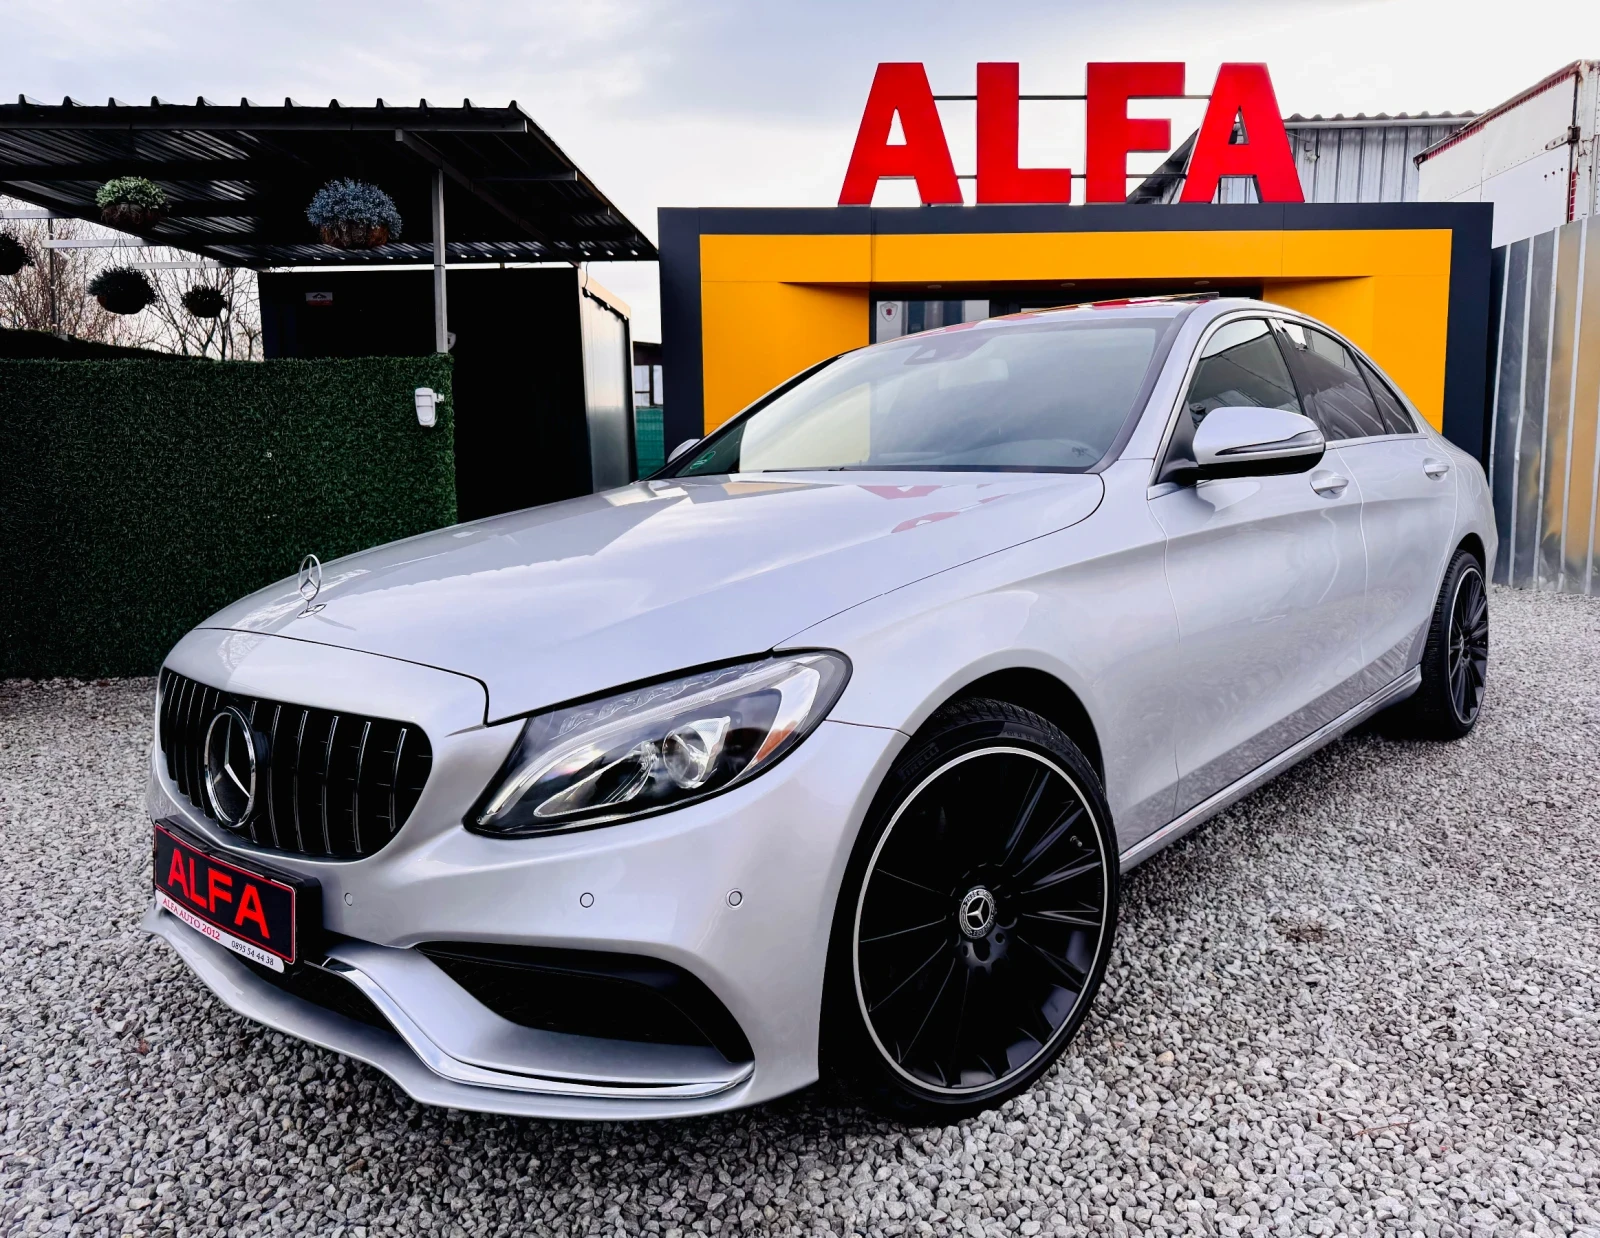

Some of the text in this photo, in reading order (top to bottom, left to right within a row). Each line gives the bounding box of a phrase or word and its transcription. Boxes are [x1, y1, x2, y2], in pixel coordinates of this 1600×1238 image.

[838, 62, 1304, 205] ALFA
[162, 897, 221, 940] ALFA AUTO 2012
[167, 848, 270, 939] ALFA
[231, 940, 274, 966] 0895 54 44 38
